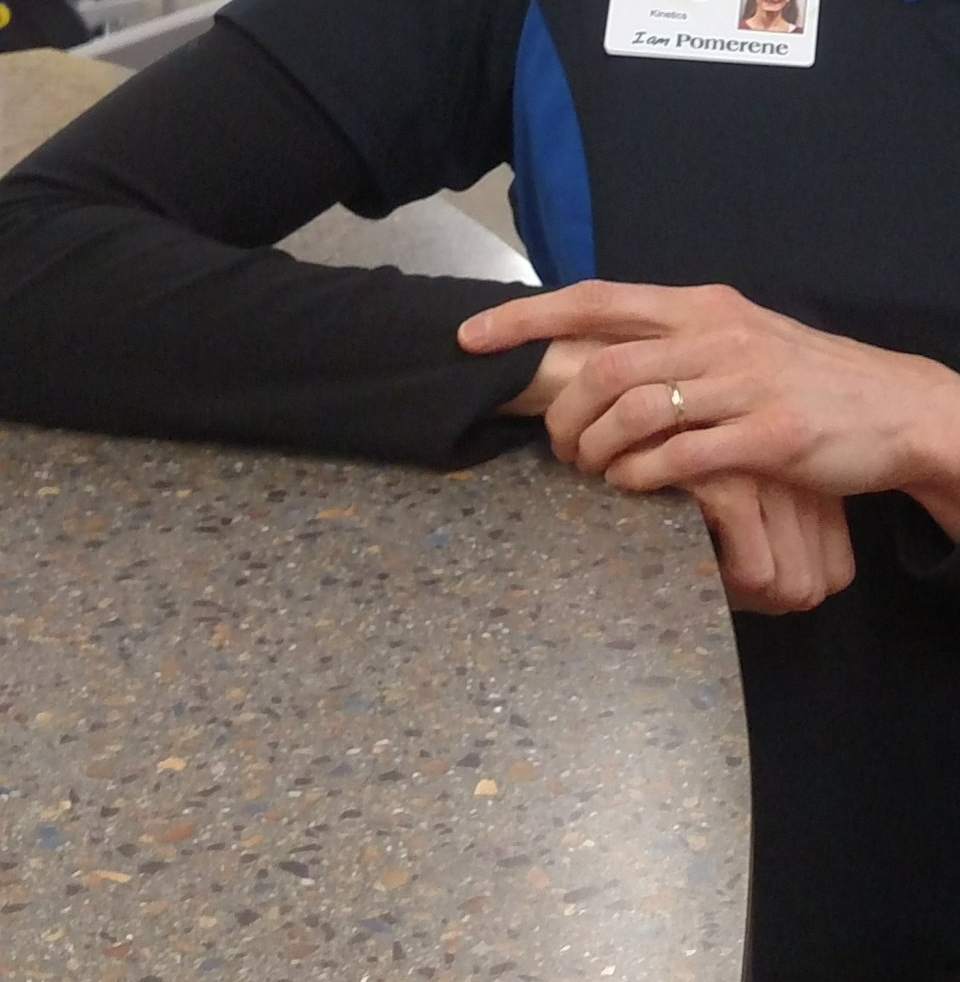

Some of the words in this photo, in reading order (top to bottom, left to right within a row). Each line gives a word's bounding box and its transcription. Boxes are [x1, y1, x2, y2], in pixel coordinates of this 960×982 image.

[649, 9, 688, 20] Kinetics
[631, 31, 647, 45] I
[646, 35, 670, 47] am
[675, 33, 789, 56] Pomerene
